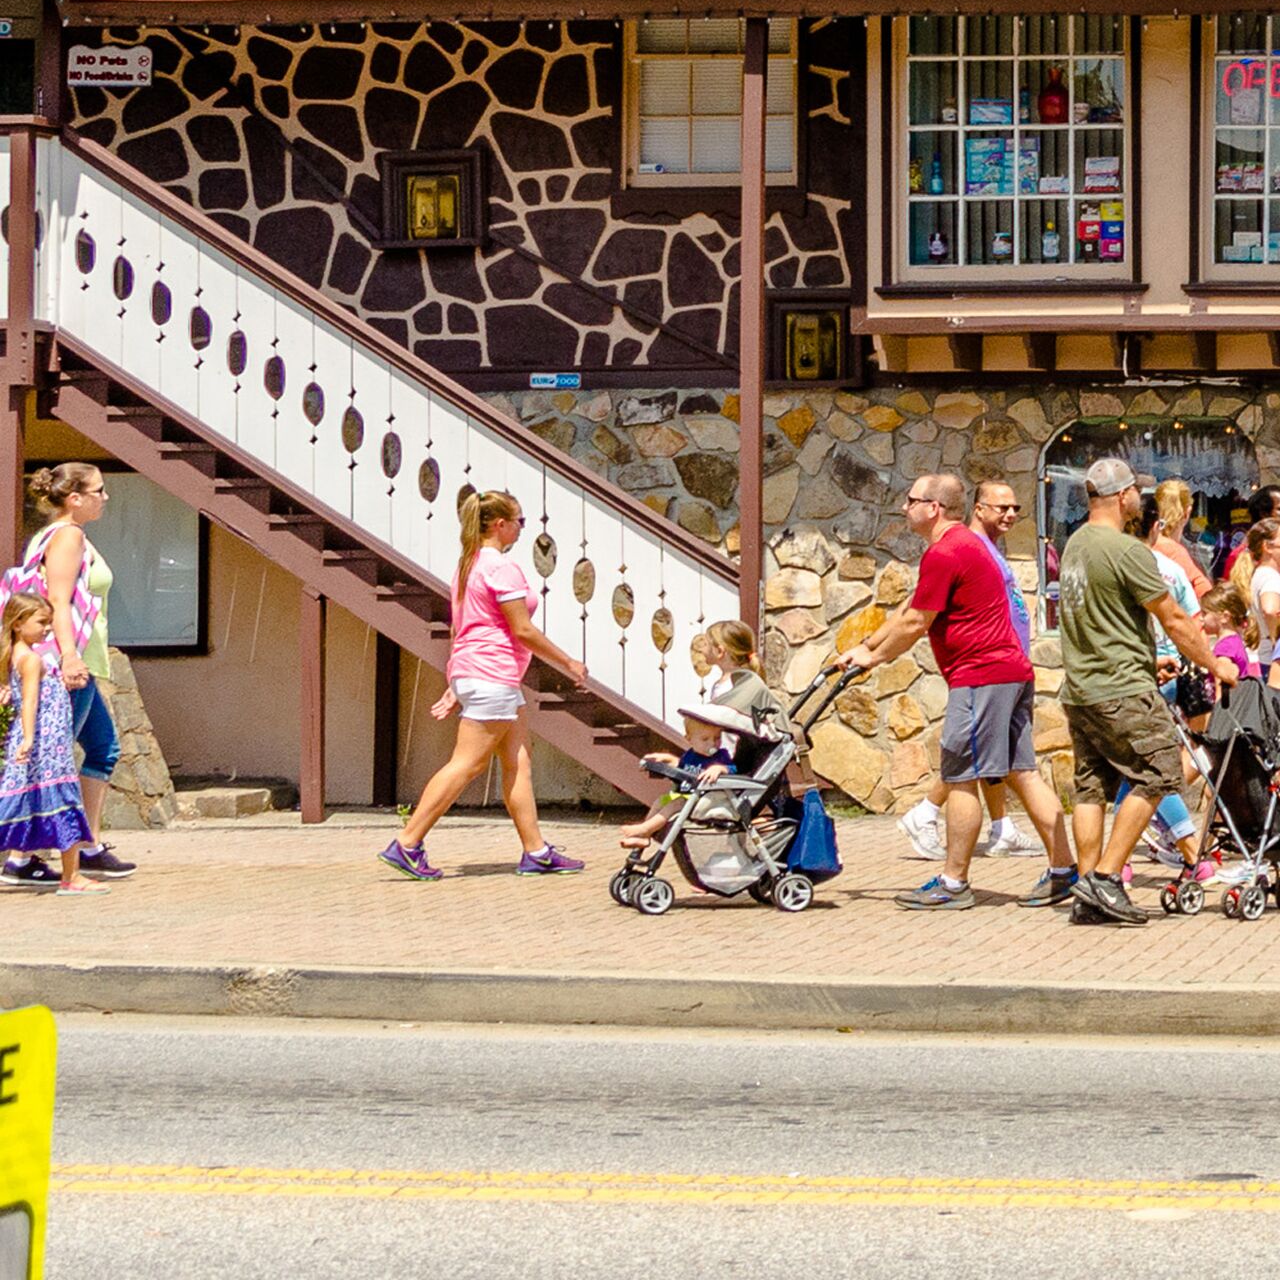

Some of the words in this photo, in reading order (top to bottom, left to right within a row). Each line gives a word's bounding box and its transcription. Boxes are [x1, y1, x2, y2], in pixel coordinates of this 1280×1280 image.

[76, 56, 96, 65] NO
[100, 56, 127, 65] Pets
[69, 72, 82, 80] NO
